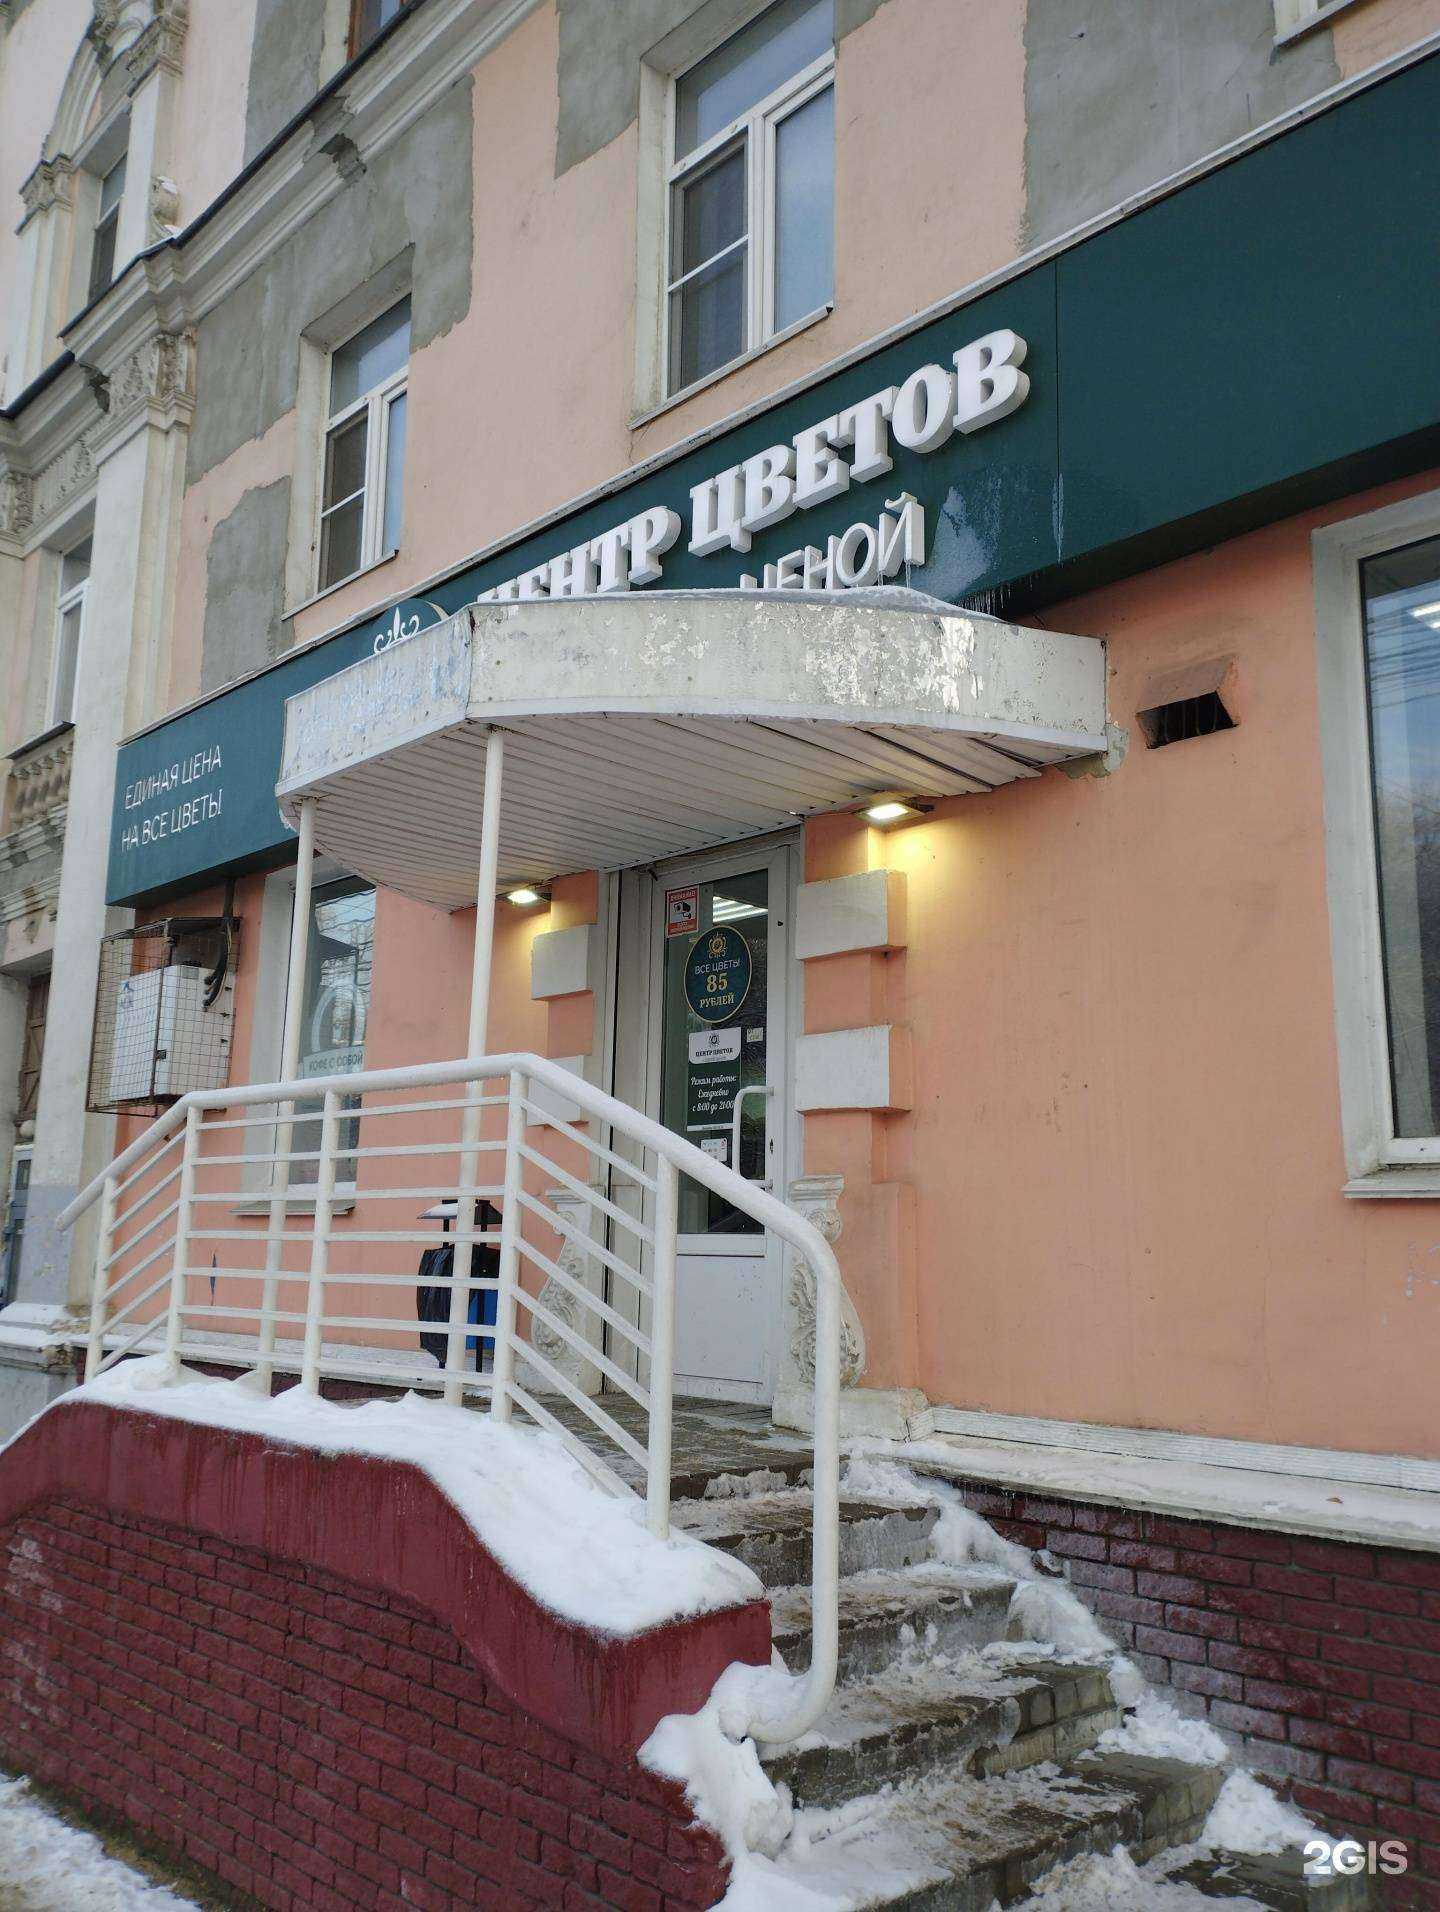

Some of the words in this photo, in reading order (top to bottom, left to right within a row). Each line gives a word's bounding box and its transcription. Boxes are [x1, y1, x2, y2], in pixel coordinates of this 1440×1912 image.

[688, 329, 1030, 557] ЦВЕТОВ
[125, 763, 178, 810] ЕДИНАЯ
[182, 744, 222, 784] ЦЕНА
[121, 824, 138, 852] НА
[142, 811, 168, 845] ВСЕ
[171, 788, 223, 833] ЦВЕТЫ
[694, 963, 711, 975] ВСЕ
[712, 958, 740, 973] ЦВЕТЫ
[706, 972, 728, 993] 85
[700, 991, 735, 1009] РУБЛЕЙ
